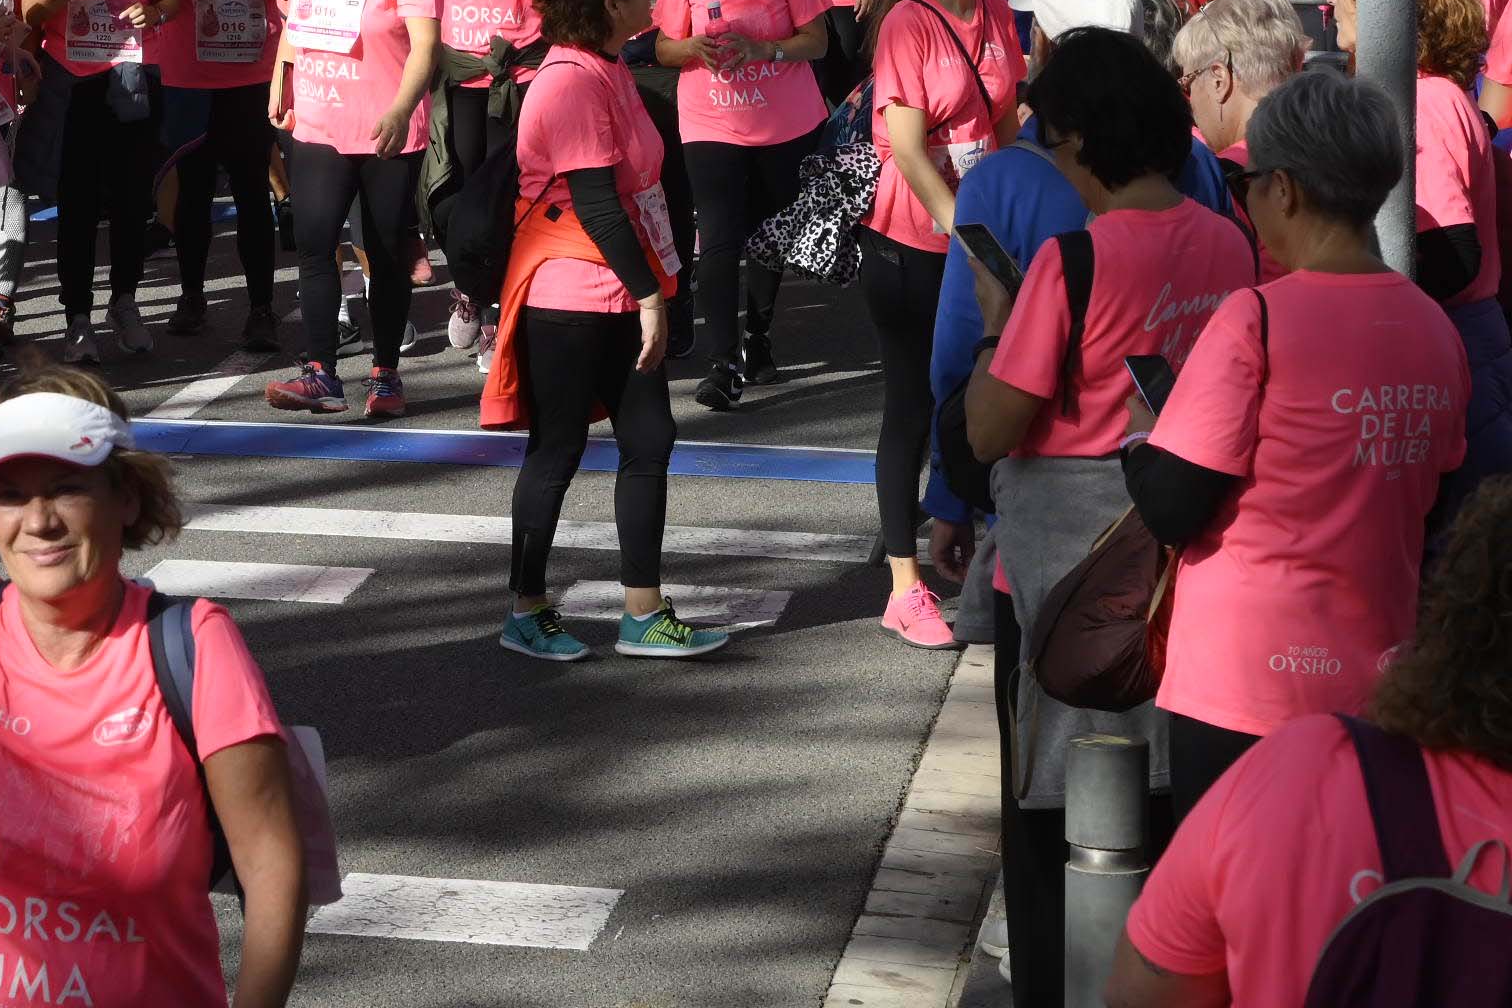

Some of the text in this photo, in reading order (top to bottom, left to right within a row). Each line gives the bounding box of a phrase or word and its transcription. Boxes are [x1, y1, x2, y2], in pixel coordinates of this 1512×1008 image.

[91, 22, 116, 33] 016
[221, 22, 246, 32] 016
[452, 27, 504, 46] SUM
[296, 55, 360, 80] DORSAL
[298, 79, 341, 101] SUMA
[709, 88, 765, 107] SUMA
[1331, 384, 1451, 414] CARRERA
[1361, 414, 1432, 440] DE LA
[1352, 440, 1430, 466] MUJER
[1289, 646, 1299, 655] 10
[1269, 654, 1342, 675] OYSHO
